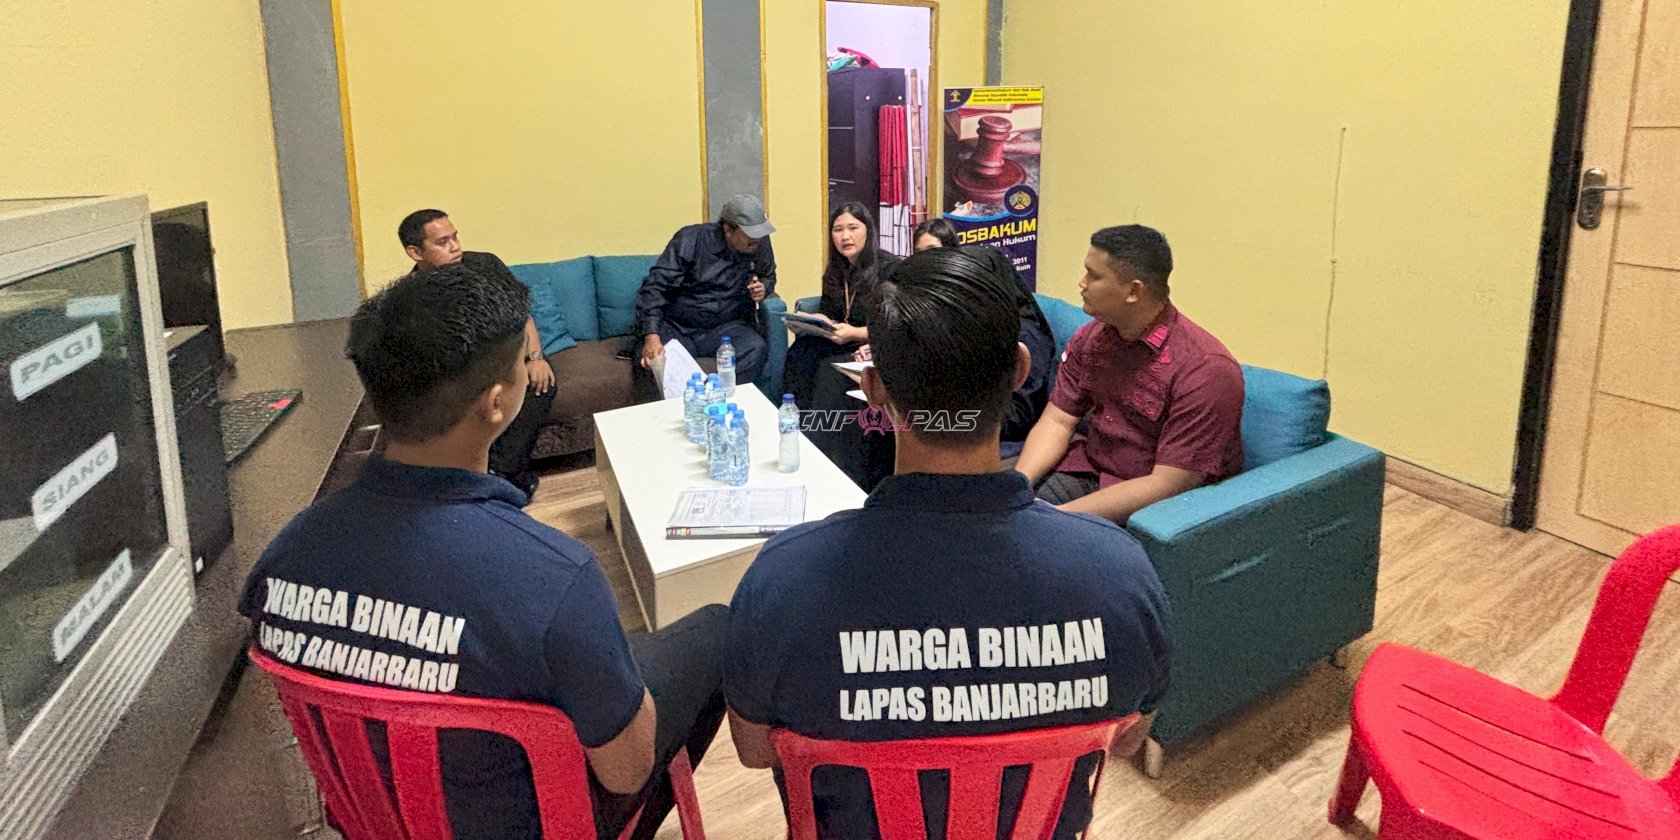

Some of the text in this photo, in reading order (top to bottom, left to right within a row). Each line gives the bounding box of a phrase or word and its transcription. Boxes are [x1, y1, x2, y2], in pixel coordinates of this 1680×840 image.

[957, 218, 1037, 245] OSBAKUM
[1002, 234, 1036, 246] Hukum
[1012, 257, 1028, 265] 2011
[20, 334, 95, 384] PAGI
[40, 448, 110, 512] SIANG
[61, 562, 126, 645] MALAM
[263, 577, 466, 655] WARGA BINAAN
[259, 621, 460, 692] LAPAS BANJARBARU
[839, 617, 1106, 673] WARGA BINAAN
[839, 675, 1108, 722] LAPAS BANJARBARU
